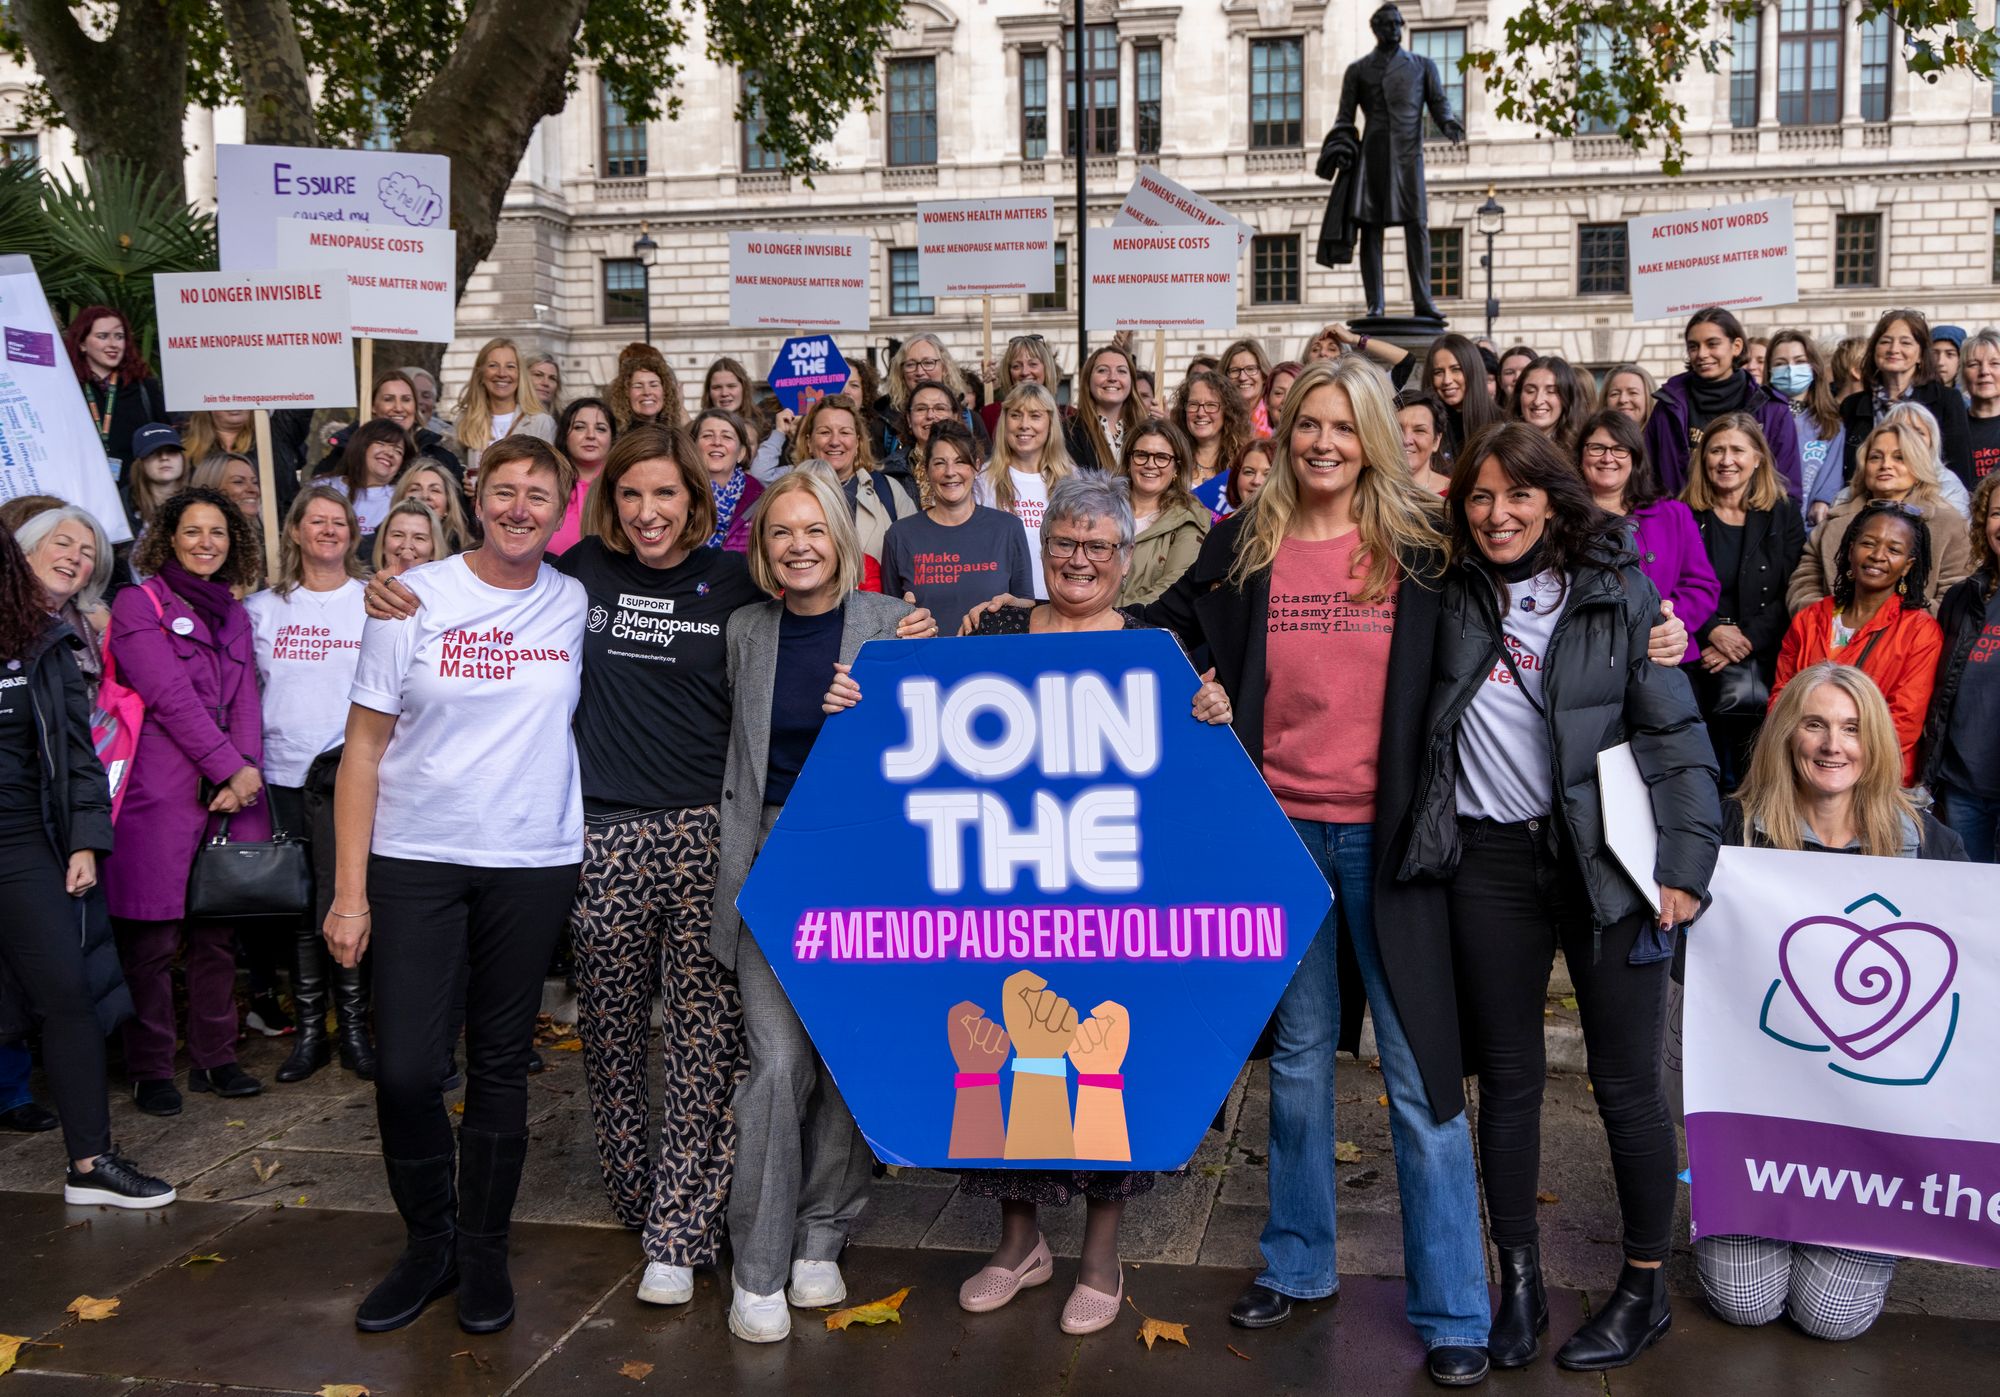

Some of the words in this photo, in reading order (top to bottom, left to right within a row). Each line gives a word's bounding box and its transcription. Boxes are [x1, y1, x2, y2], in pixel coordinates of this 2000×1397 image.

[1140, 176, 1177, 204] WOMENS
[1174, 197, 1207, 223] HEALTH
[923, 211, 965, 223] WOMENS
[967, 209, 1002, 221] HEALTH
[1004, 208, 1047, 220] MATTERS
[1125, 206, 1145, 222] MAKE
[1652, 221, 1699, 239] ACTIONS
[1701, 218, 1724, 232] NOT
[1727, 211, 1769, 228] WORDS
[310, 232, 385, 250] MENOPAUSE
[388, 239, 424, 253] COSTS
[748, 243, 761, 254] NO
[764, 244, 802, 255] LONGER
[804, 245, 852, 257] INVISIBLE
[924, 245, 945, 254] MAKE
[947, 243, 992, 253] MENOPAUSE
[994, 241, 1024, 251] MATTER
[1026, 241, 1048, 250] NOW!
[1113, 238, 1176, 250] MENOPAUSE
[1178, 237, 1210, 249] COSTS
[1638, 264, 1663, 275] MAKE
[1665, 255, 1720, 270] MENOPAUSE
[1722, 250, 1759, 263] MATTER
[1761, 246, 1788, 259] NOW!
[379, 278, 418, 290] MATTER
[420, 281, 447, 292] NOW!
[735, 275, 758, 285] MAKE
[759, 276, 807, 287] MENOPAUSE
[809, 278, 840, 287] MATTER
[842, 279, 864, 288] NOW!
[1092, 274, 1116, 284] MAKE
[1118, 274, 1169, 283] MENOPAUSE
[1171, 273, 1204, 283] MATTER
[1206, 273, 1231, 283] NOW!
[180, 289, 199, 303] NO
[202, 287, 253, 303] LONGER
[256, 284, 322, 301] INVISIBLE
[168, 336, 198, 349] MAKE
[200, 334, 263, 348] MENOPAUSE
[266, 333, 309, 346] MATTER
[312, 332, 342, 345] NOW!
[788, 340, 829, 360] JOIN
[791, 358, 826, 376] THE
[203, 395, 218, 403] Join
[219, 394, 230, 403] the
[232, 393, 314, 403] #menopauserevolution
[914, 552, 961, 564] #Make
[914, 561, 998, 575] Menopause
[914, 574, 960, 586] Matter
[626, 597, 671, 611] SUPPORT
[614, 611, 623, 624] The
[622, 610, 720, 636] Menopause
[1267, 621, 1393, 634] otasmyflushe
[277, 625, 331, 637] #Make
[442, 626, 514, 645] #Make
[611, 624, 675, 647] Charity
[274, 636, 362, 651] Menopaus
[272, 647, 328, 661] Matter
[441, 643, 570, 665] Menopause
[607, 649, 676, 663] themenopausecharity.org
[439, 659, 515, 680] Matter
[884, 672, 1158, 778] JOIN
[908, 789, 1139, 890] THE
[794, 907, 1284, 960] #MENOPAUSEREVOLUTION
